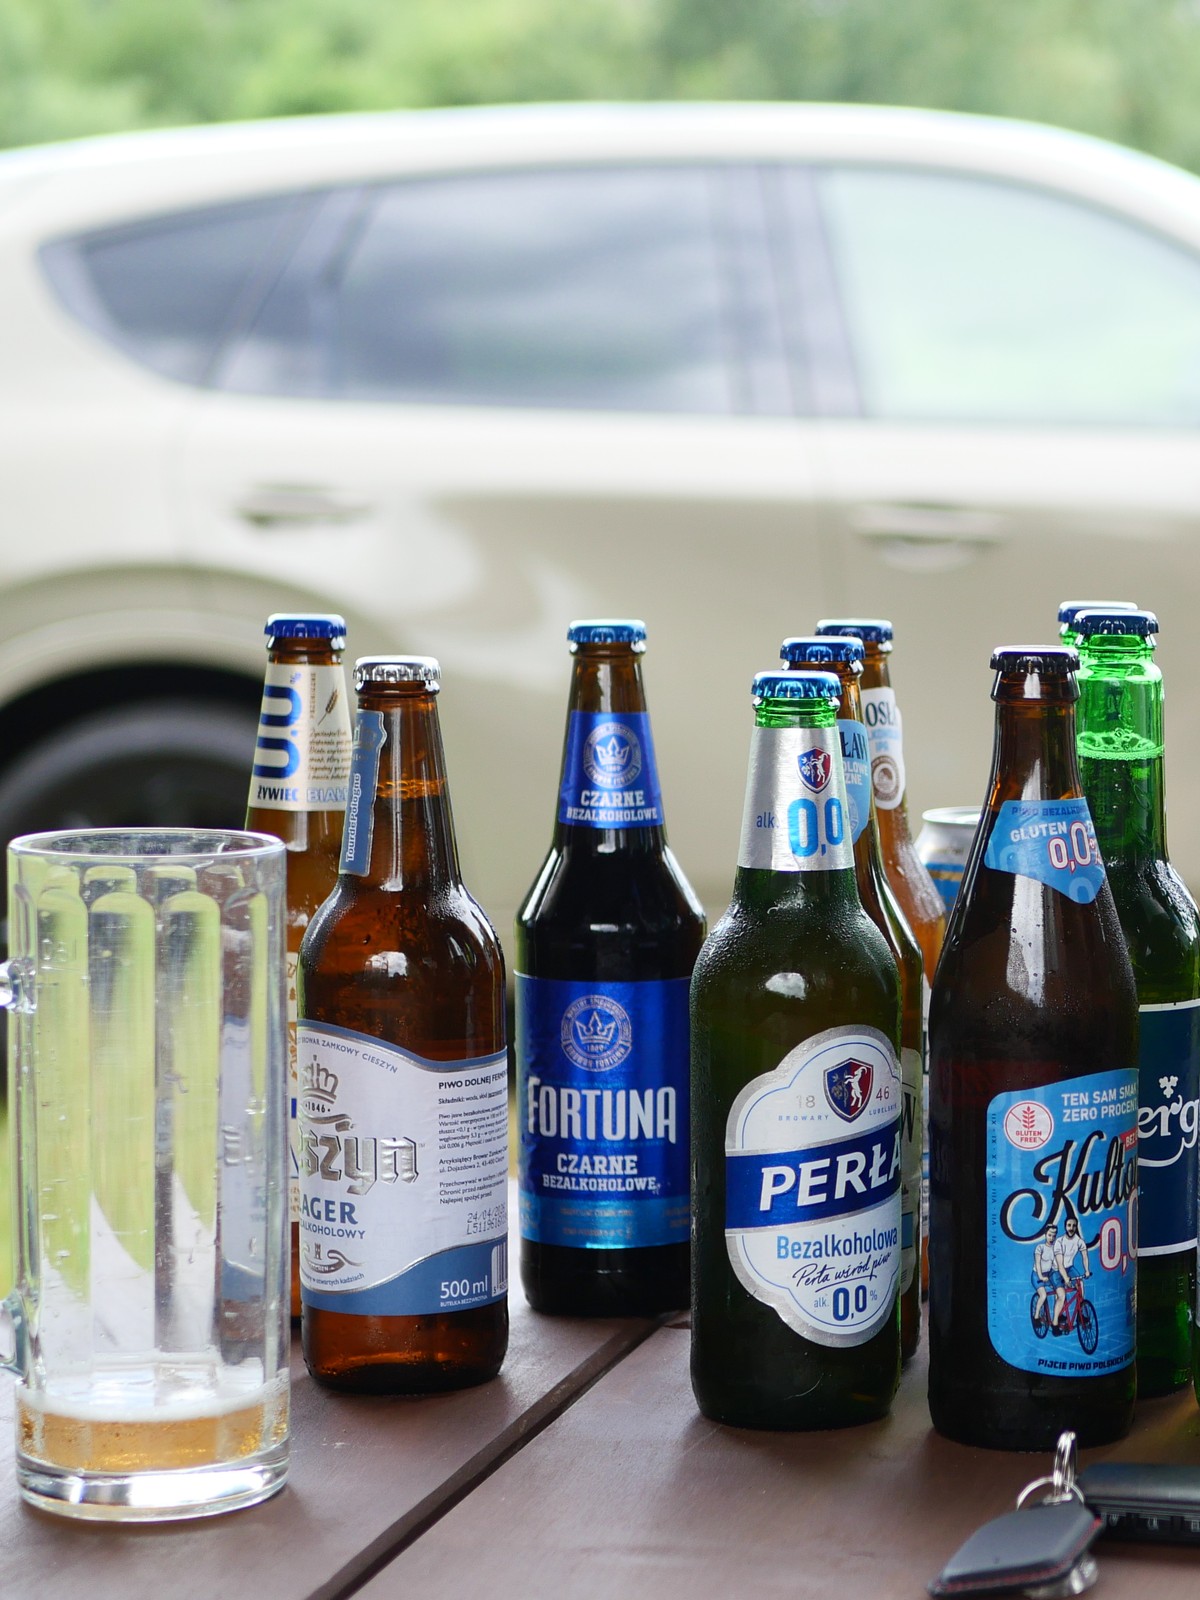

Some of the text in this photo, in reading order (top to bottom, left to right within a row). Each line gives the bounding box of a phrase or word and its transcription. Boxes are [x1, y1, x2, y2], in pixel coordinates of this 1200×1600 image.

[257, 784, 349, 803] ŻYWIEC BIAŁ
[581, 790, 645, 807] CZARNE
[566, 806, 658, 822] BEZALKOHOLOWE
[1010, 821, 1067, 842] GLUTEN
[321, 1040, 360, 1057] ZAMKOWY
[361, 1053, 398, 1074] CIESZYN
[438, 1080, 463, 1090] PIWO
[464, 1075, 492, 1086] DOLNEJ
[796, 1086, 890, 1108] 18 46
[1061, 1092, 1089, 1106] TEN
[1093, 1088, 1117, 1104] SAM
[528, 1076, 677, 1144] FORTUNA
[868, 1103, 898, 1116] LUBELSKIE
[1062, 1107, 1098, 1122] ZERO
[1015, 1130, 1042, 1138] GLUTEN
[1020, 1136, 1038, 1144] FREE
[557, 1154, 638, 1175] CZARNE
[758, 1130, 901, 1211] PERŁA
[542, 1174, 656, 1192] BEZALKOHOLOWE
[1000, 1130, 1137, 1248] Kulto
[777, 1226, 898, 1259] Bezalkoholowa
[834, 1260, 870, 1279] wśród
[869, 1252, 891, 1281] piw
[440, 1279, 470, 1299] 500
[472, 1275, 488, 1294] ml
[813, 1296, 830, 1308] alk.
[1038, 1358, 1067, 1370] PIJCIE
[1069, 1361, 1093, 1371] PIWO
